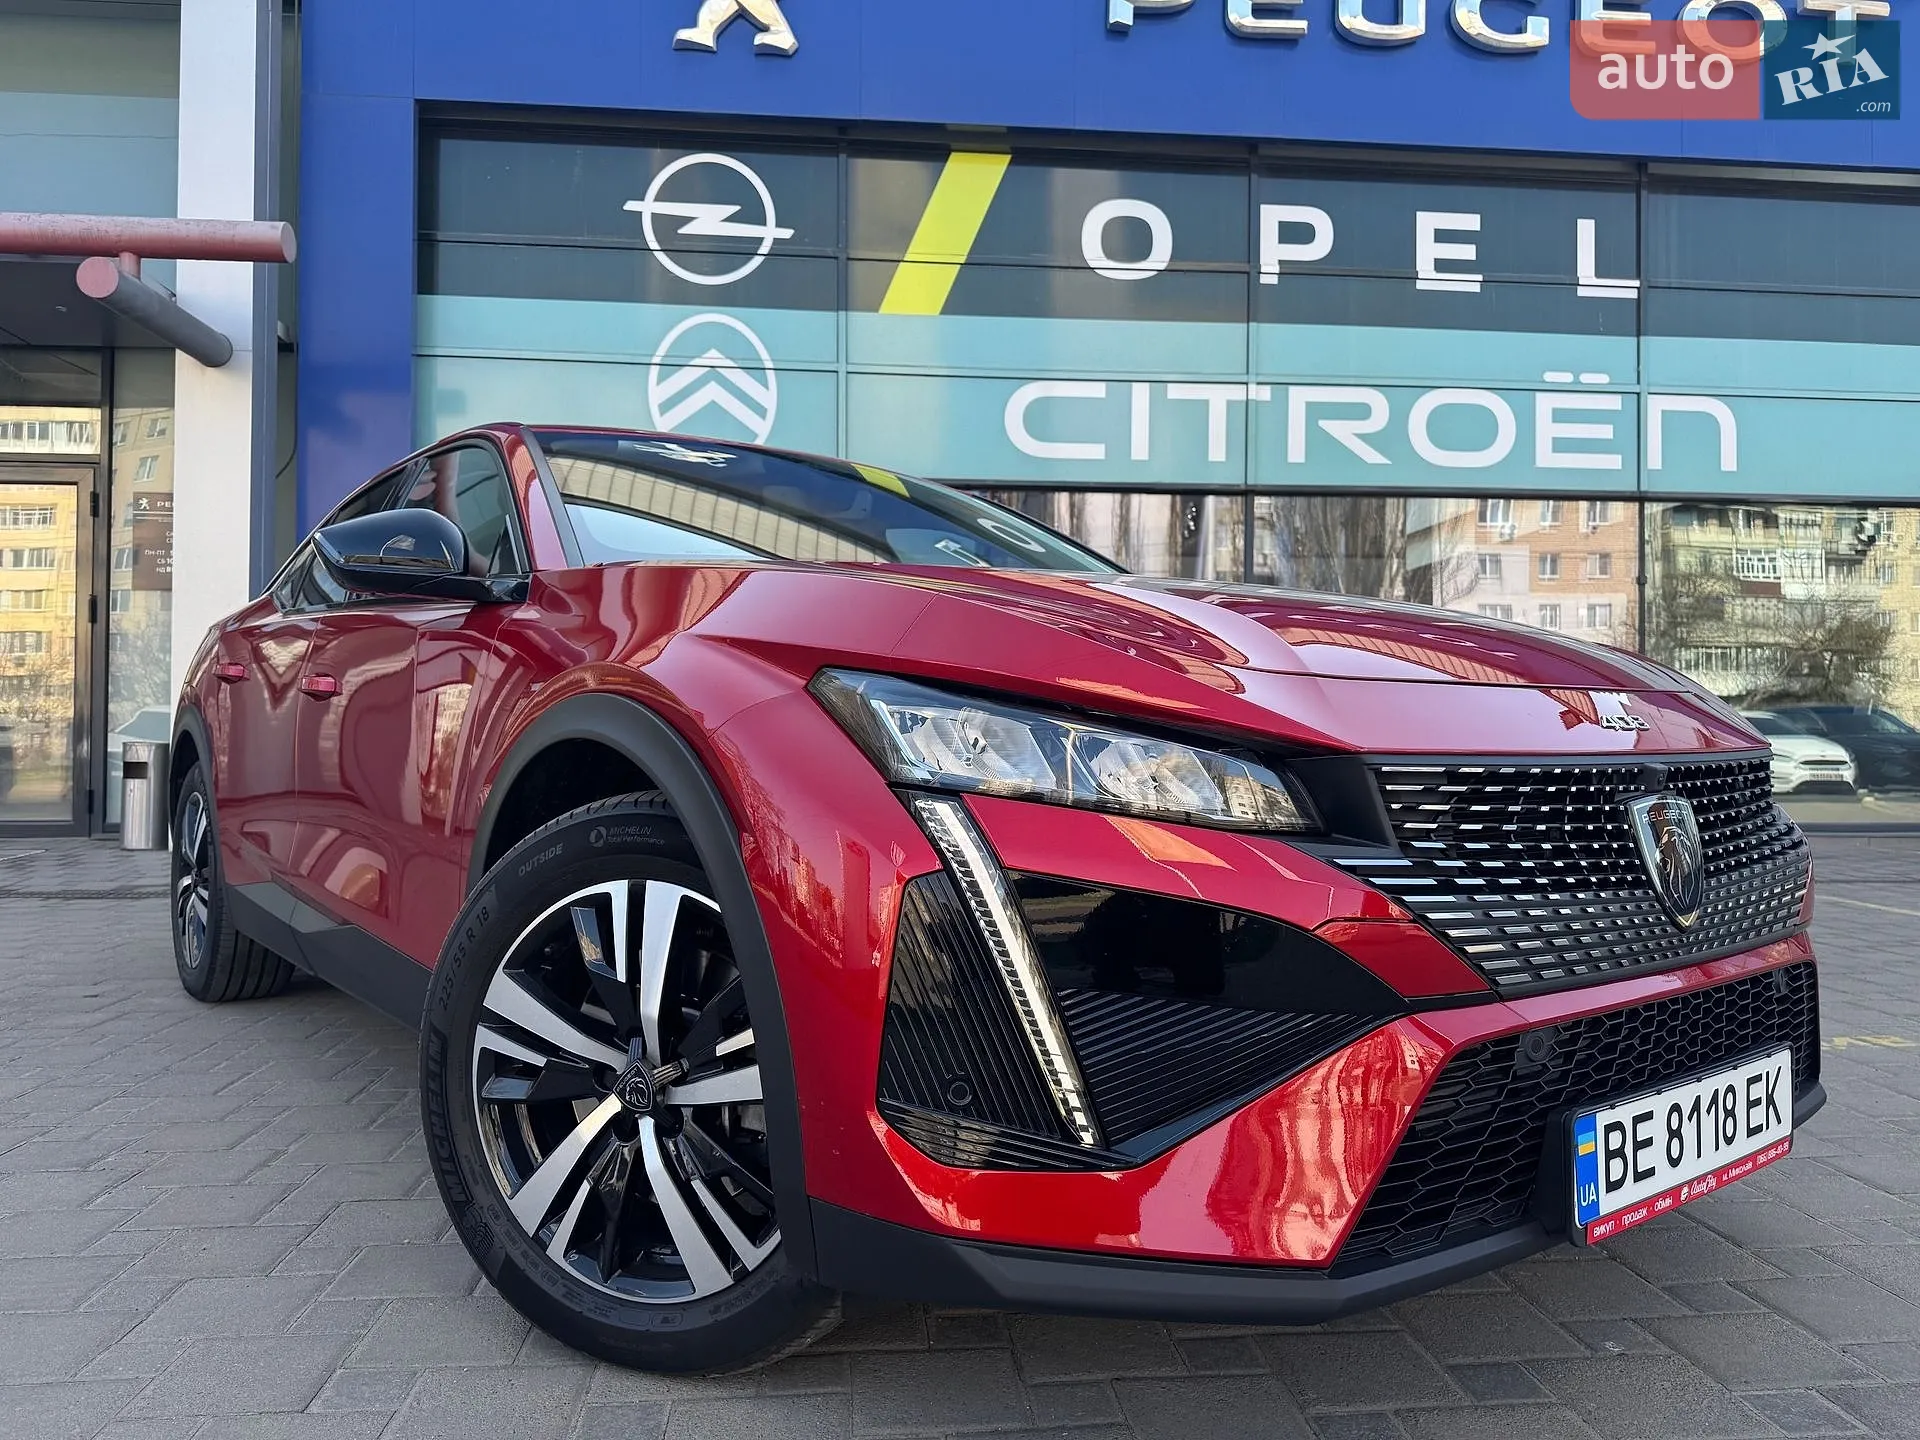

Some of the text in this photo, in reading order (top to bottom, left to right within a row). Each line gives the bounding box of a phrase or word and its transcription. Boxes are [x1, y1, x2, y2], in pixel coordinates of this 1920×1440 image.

[1080, 198, 1641, 299] OPEL
[1003, 371, 1738, 472] CITROËN
[609, 826, 652, 836] MICHELIN
[1641, 809, 1688, 824] PEUGEOT
[518, 842, 565, 877] OUTSIDE
[465, 929, 477, 944] R
[477, 905, 491, 927] 18
[426, 1030, 472, 1203] MICHELIN
[1603, 1065, 1783, 1194] BE 8118 EK
[1580, 1182, 1597, 1207] UA
[1593, 1220, 1615, 1237] викуп
[1621, 1206, 1648, 1227] продаж
[1654, 1195, 1673, 1211] обмін
